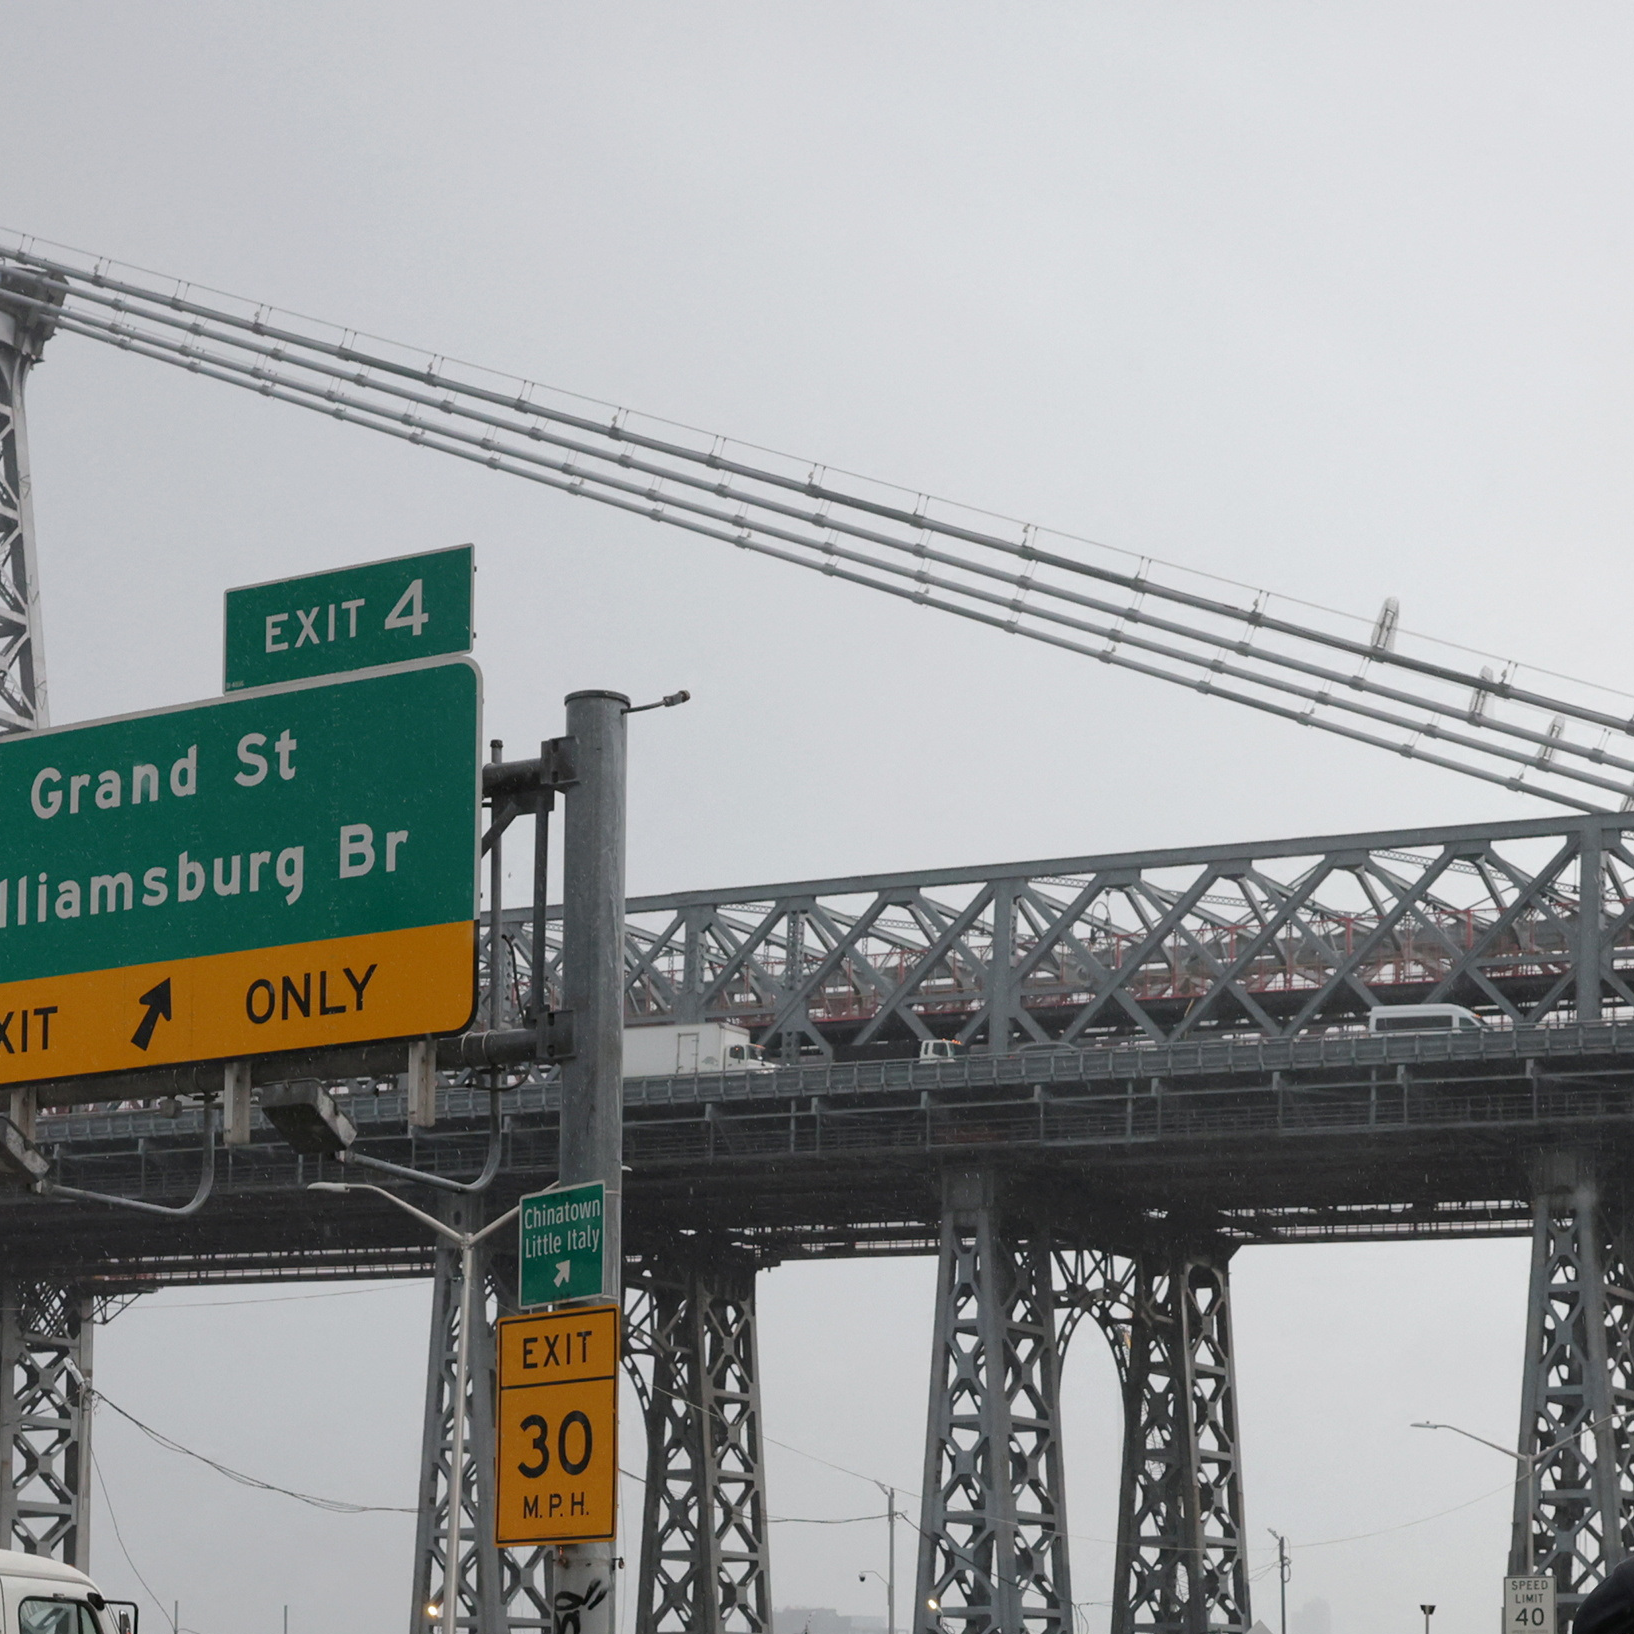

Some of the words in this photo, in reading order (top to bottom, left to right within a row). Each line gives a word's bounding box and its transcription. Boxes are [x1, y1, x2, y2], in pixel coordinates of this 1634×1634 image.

[264, 598, 366, 653] EXIT
[384, 578, 429, 635] 4
[29, 744, 197, 821] Grand
[235, 728, 298, 787] St
[338, 823, 410, 878] Br
[244, 964, 378, 1024] ONLY
[524, 1199, 601, 1230] Chinatown
[525, 1232, 562, 1259] Little
[567, 1225, 601, 1253] Italy
[522, 1330, 593, 1370] EXIT
[517, 1409, 593, 1479] 30
[1511, 1580, 1549, 1591] SPEED
[1515, 1593, 1544, 1604] LIMIT
[1515, 1607, 1545, 1627] 40
